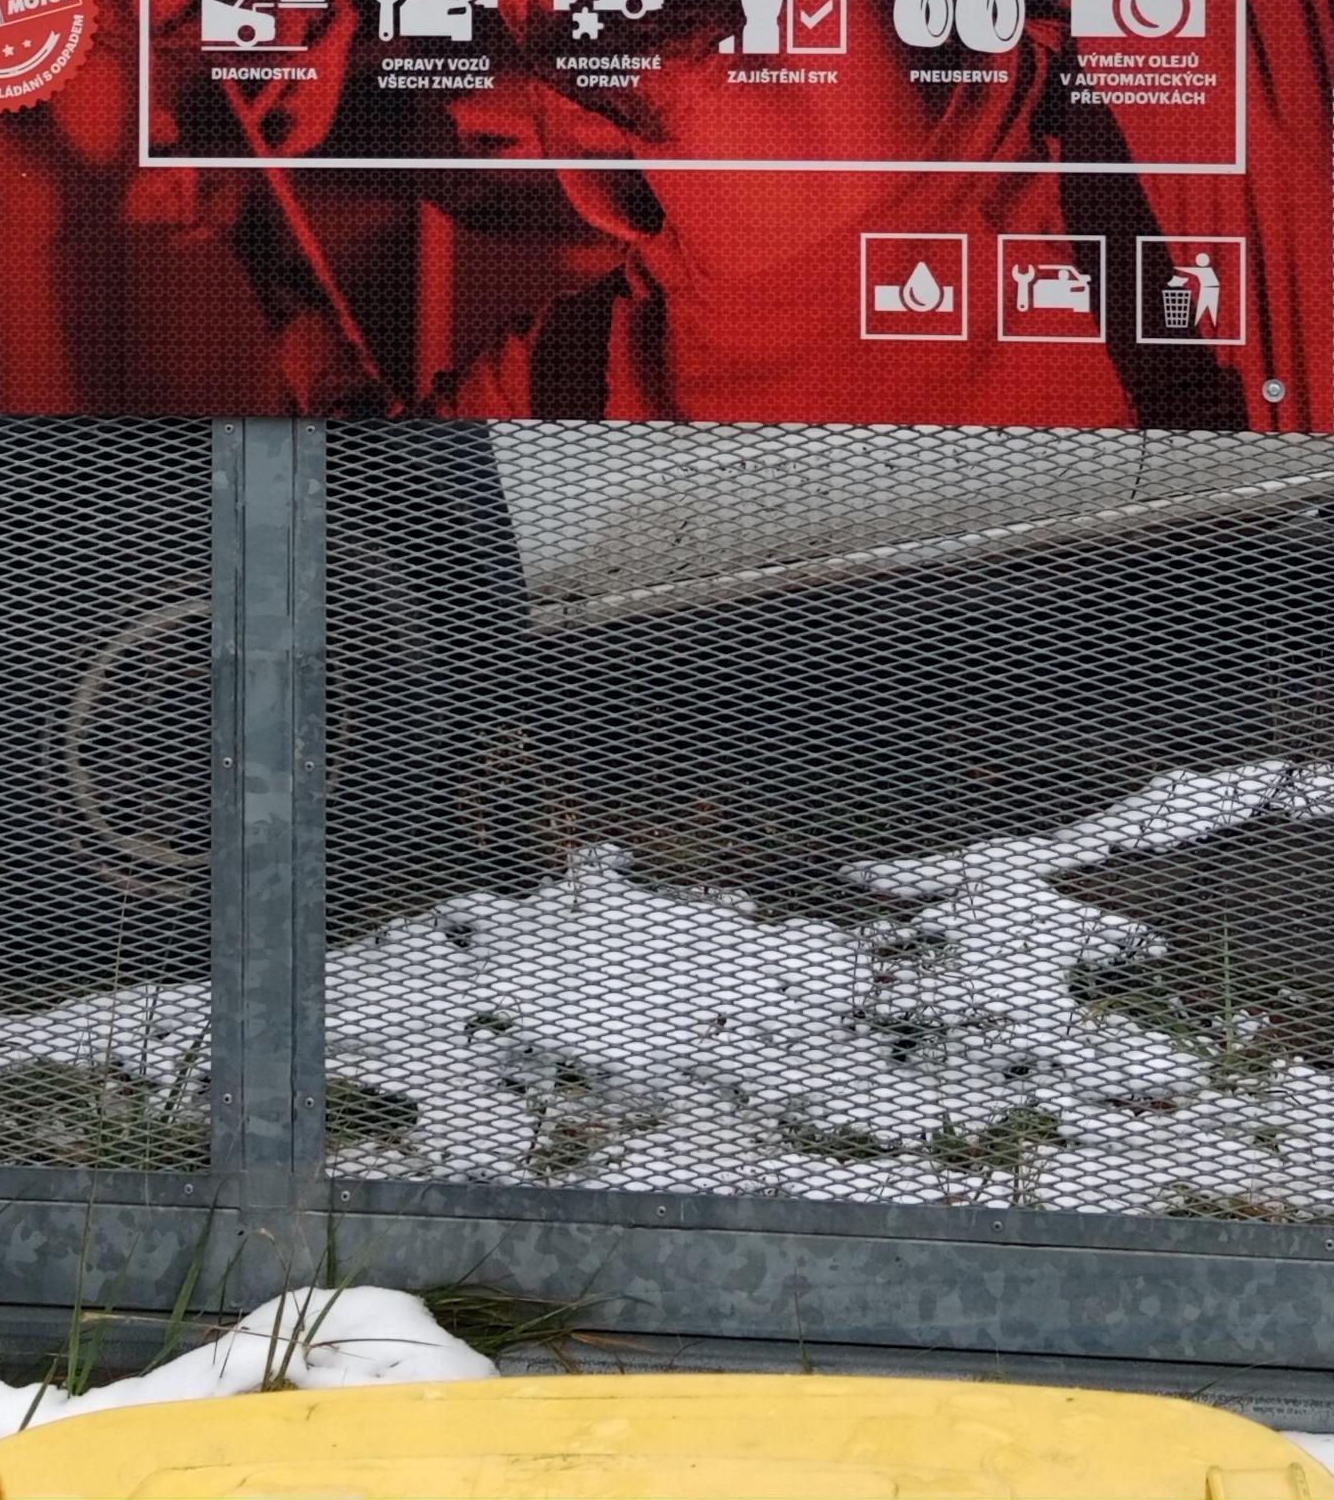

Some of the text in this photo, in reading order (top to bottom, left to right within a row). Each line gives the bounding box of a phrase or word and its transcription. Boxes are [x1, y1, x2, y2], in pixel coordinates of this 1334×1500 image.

[43, 72, 53, 82] S
[50, 14, 84, 73] ODPADEM
[381, 56, 491, 73] OPRAVY VOZŮ
[556, 54, 662, 71] KAROSÁŘSKÉ
[1077, 51, 1199, 70] VÝMĚNY OLEJŮ
[211, 67, 318, 81] DIAGNOSTIKA
[377, 72, 495, 90] VŠECH ZNAČEK
[576, 74, 640, 89] OPRAVY
[727, 67, 838, 84] ZAJIŠTĚNÍ STK
[909, 70, 1009, 84] PNEUSERVIS
[1060, 71, 1216, 87] V AUTOMATICKÝCH
[1070, 89, 1206, 106] PŘEVODOVKÁCH
